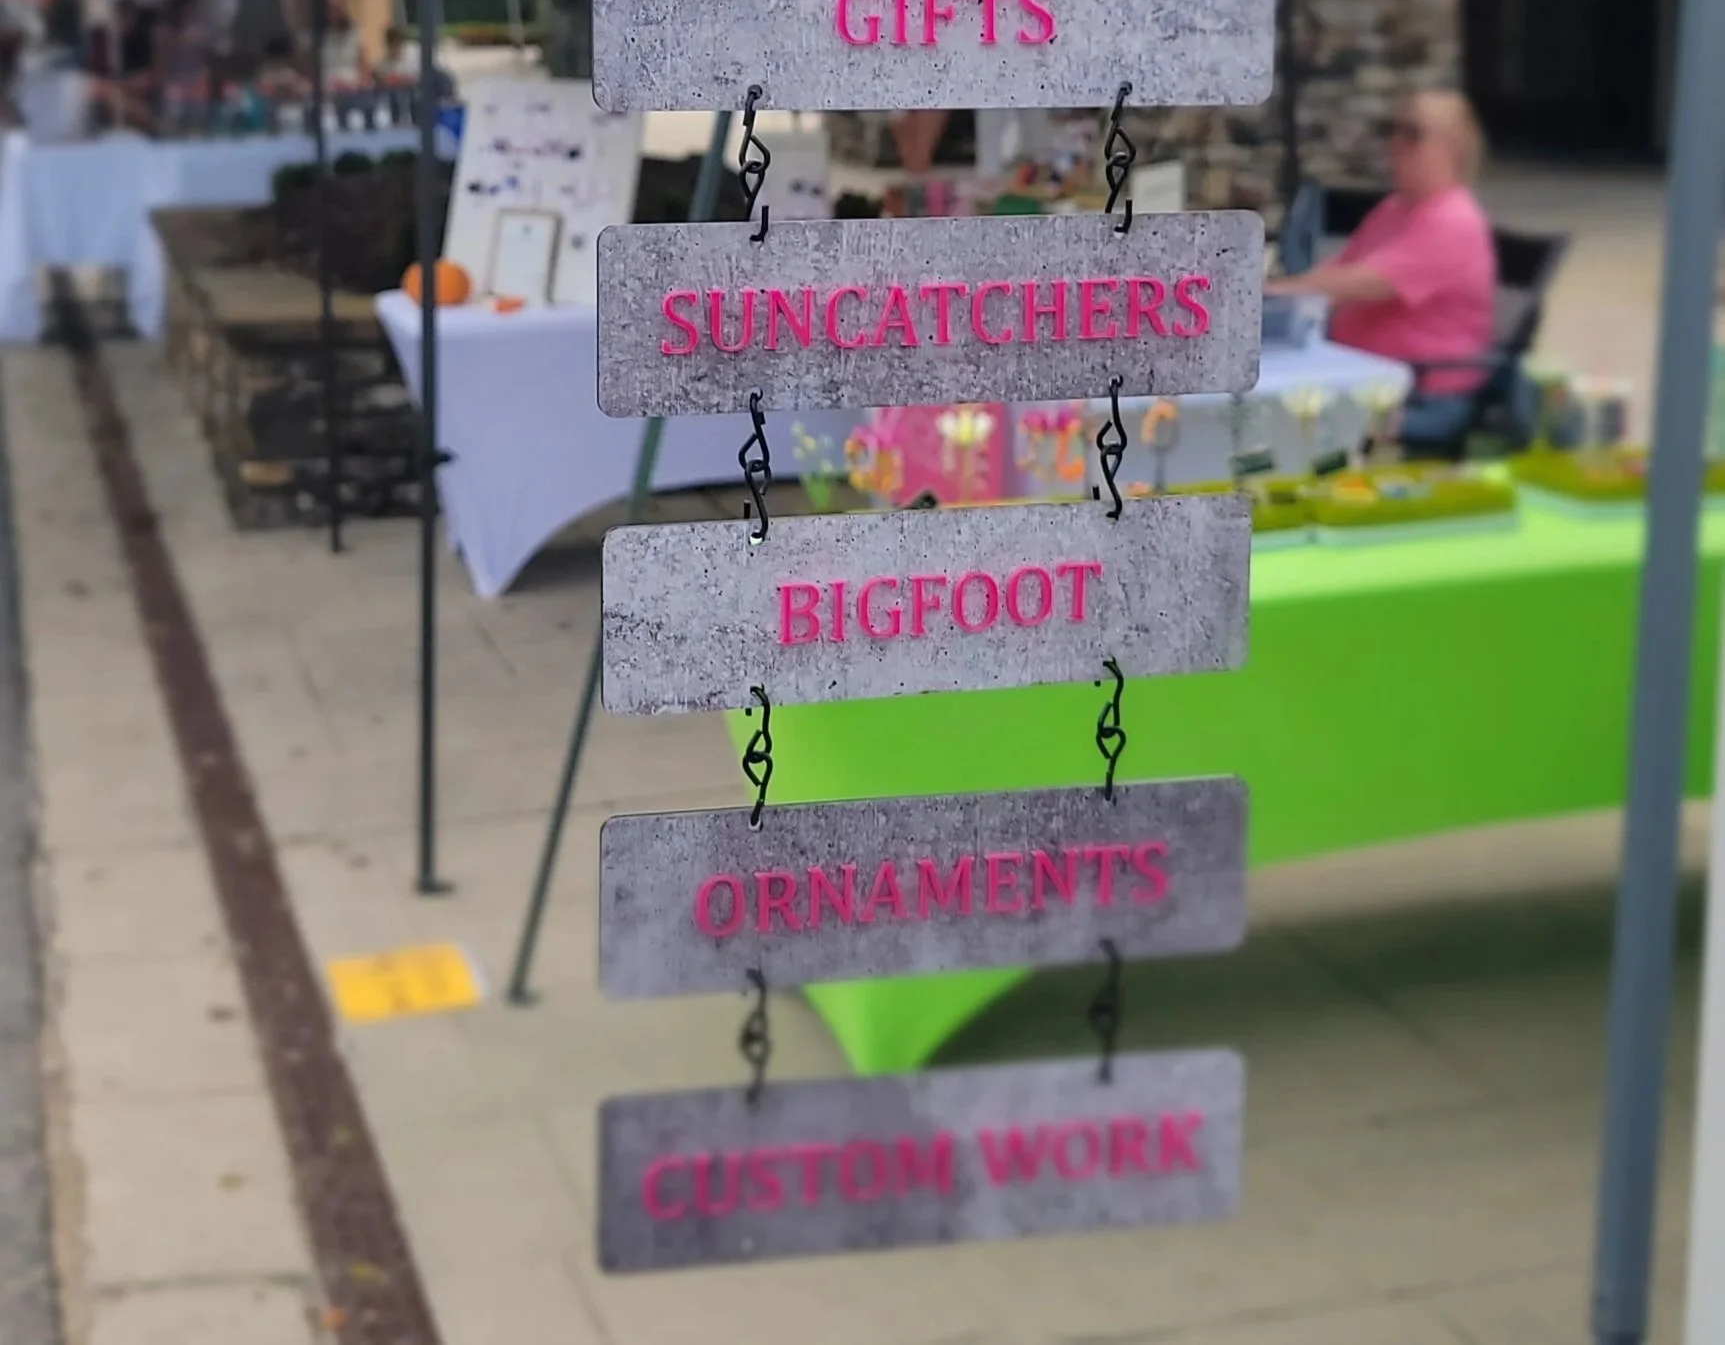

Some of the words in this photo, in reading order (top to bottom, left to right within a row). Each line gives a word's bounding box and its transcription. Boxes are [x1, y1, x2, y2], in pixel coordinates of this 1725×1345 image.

[660, 274, 1211, 357] SUNCATCHERS
[779, 562, 1103, 646] BIGFOOT
[694, 842, 1169, 937] ORNAMENTS
[642, 1131, 954, 1219] CUSTOM
[979, 1110, 1202, 1187] WORK
